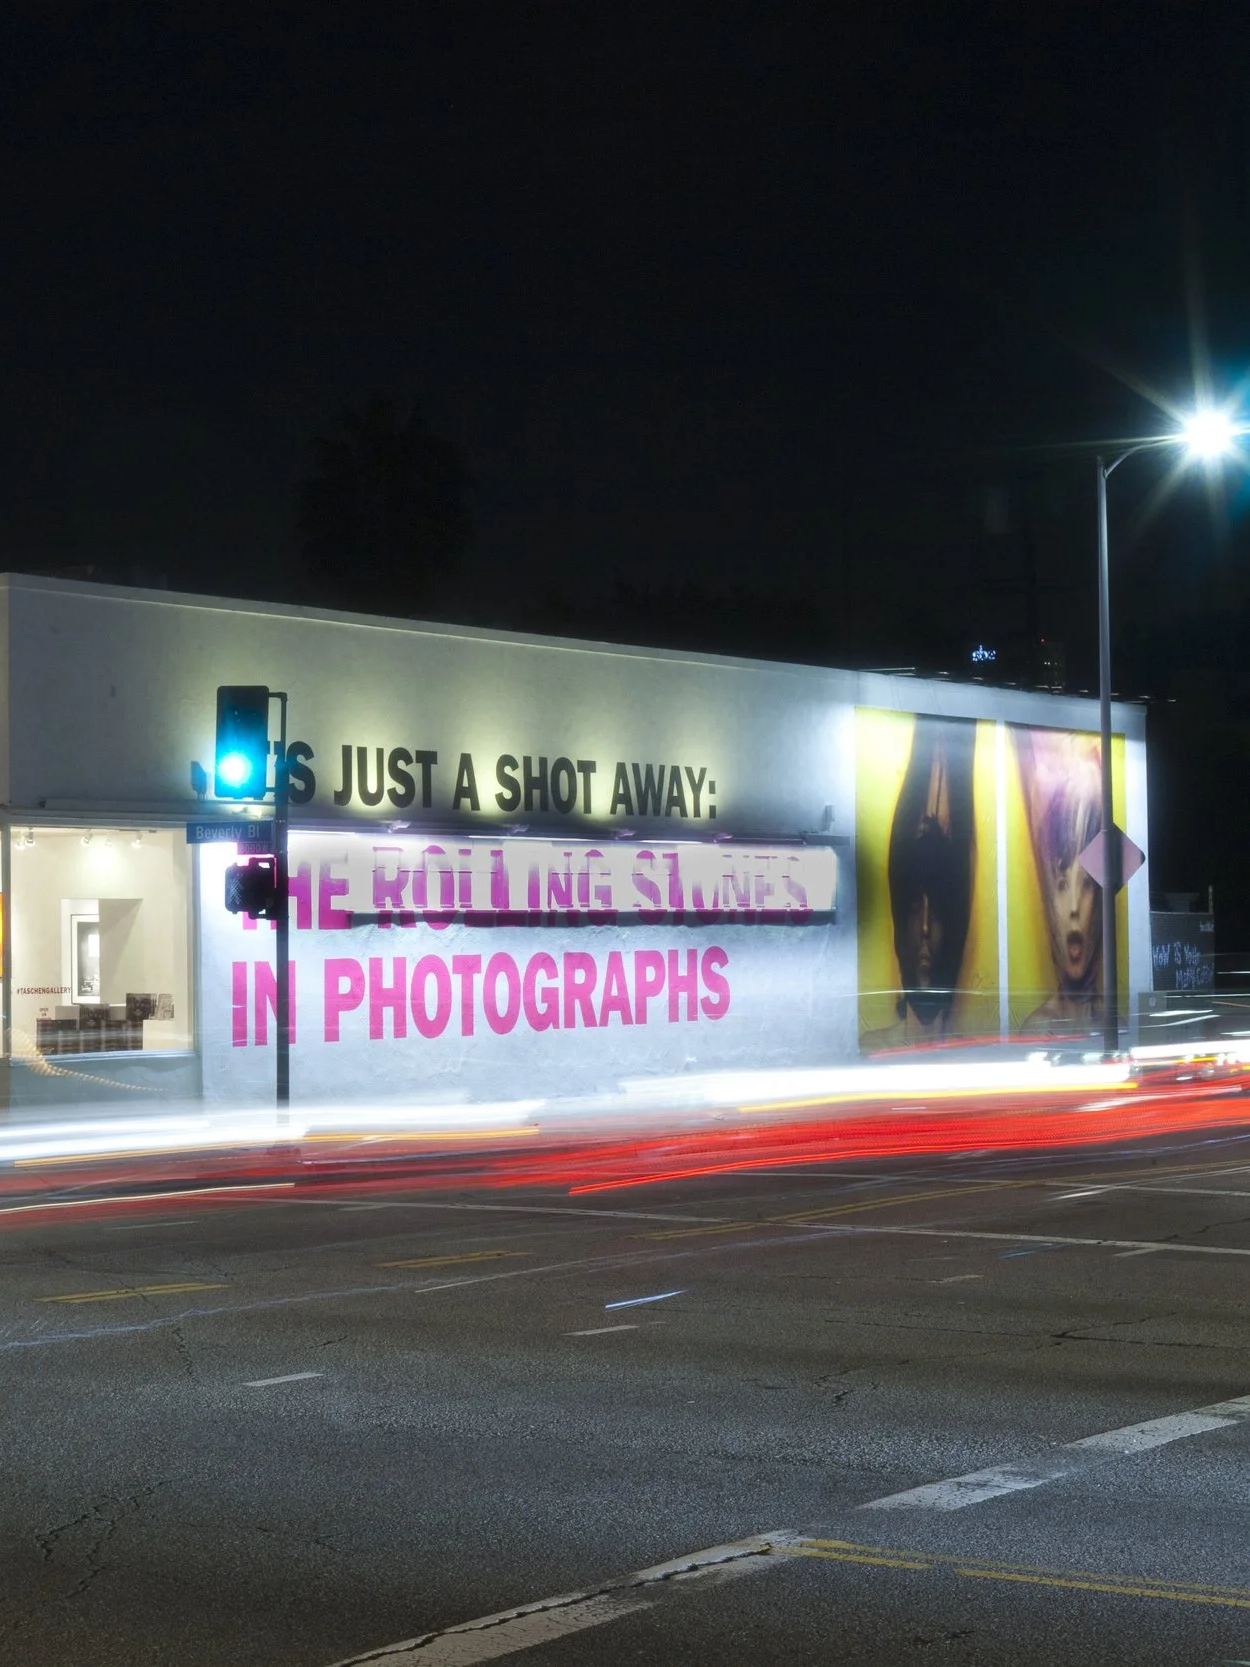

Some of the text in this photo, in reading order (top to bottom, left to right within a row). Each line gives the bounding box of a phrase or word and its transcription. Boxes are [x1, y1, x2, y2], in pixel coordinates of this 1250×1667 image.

[334, 745, 438, 808] JUST
[453, 753, 481, 811] A
[495, 754, 596, 814] SHOT
[611, 761, 717, 818] AWAY:
[196, 826, 242, 840] Beverly
[16, 986, 71, 994] #TASCHENGALLERY
[232, 946, 730, 1047] IN PHOTOGRAPHS
